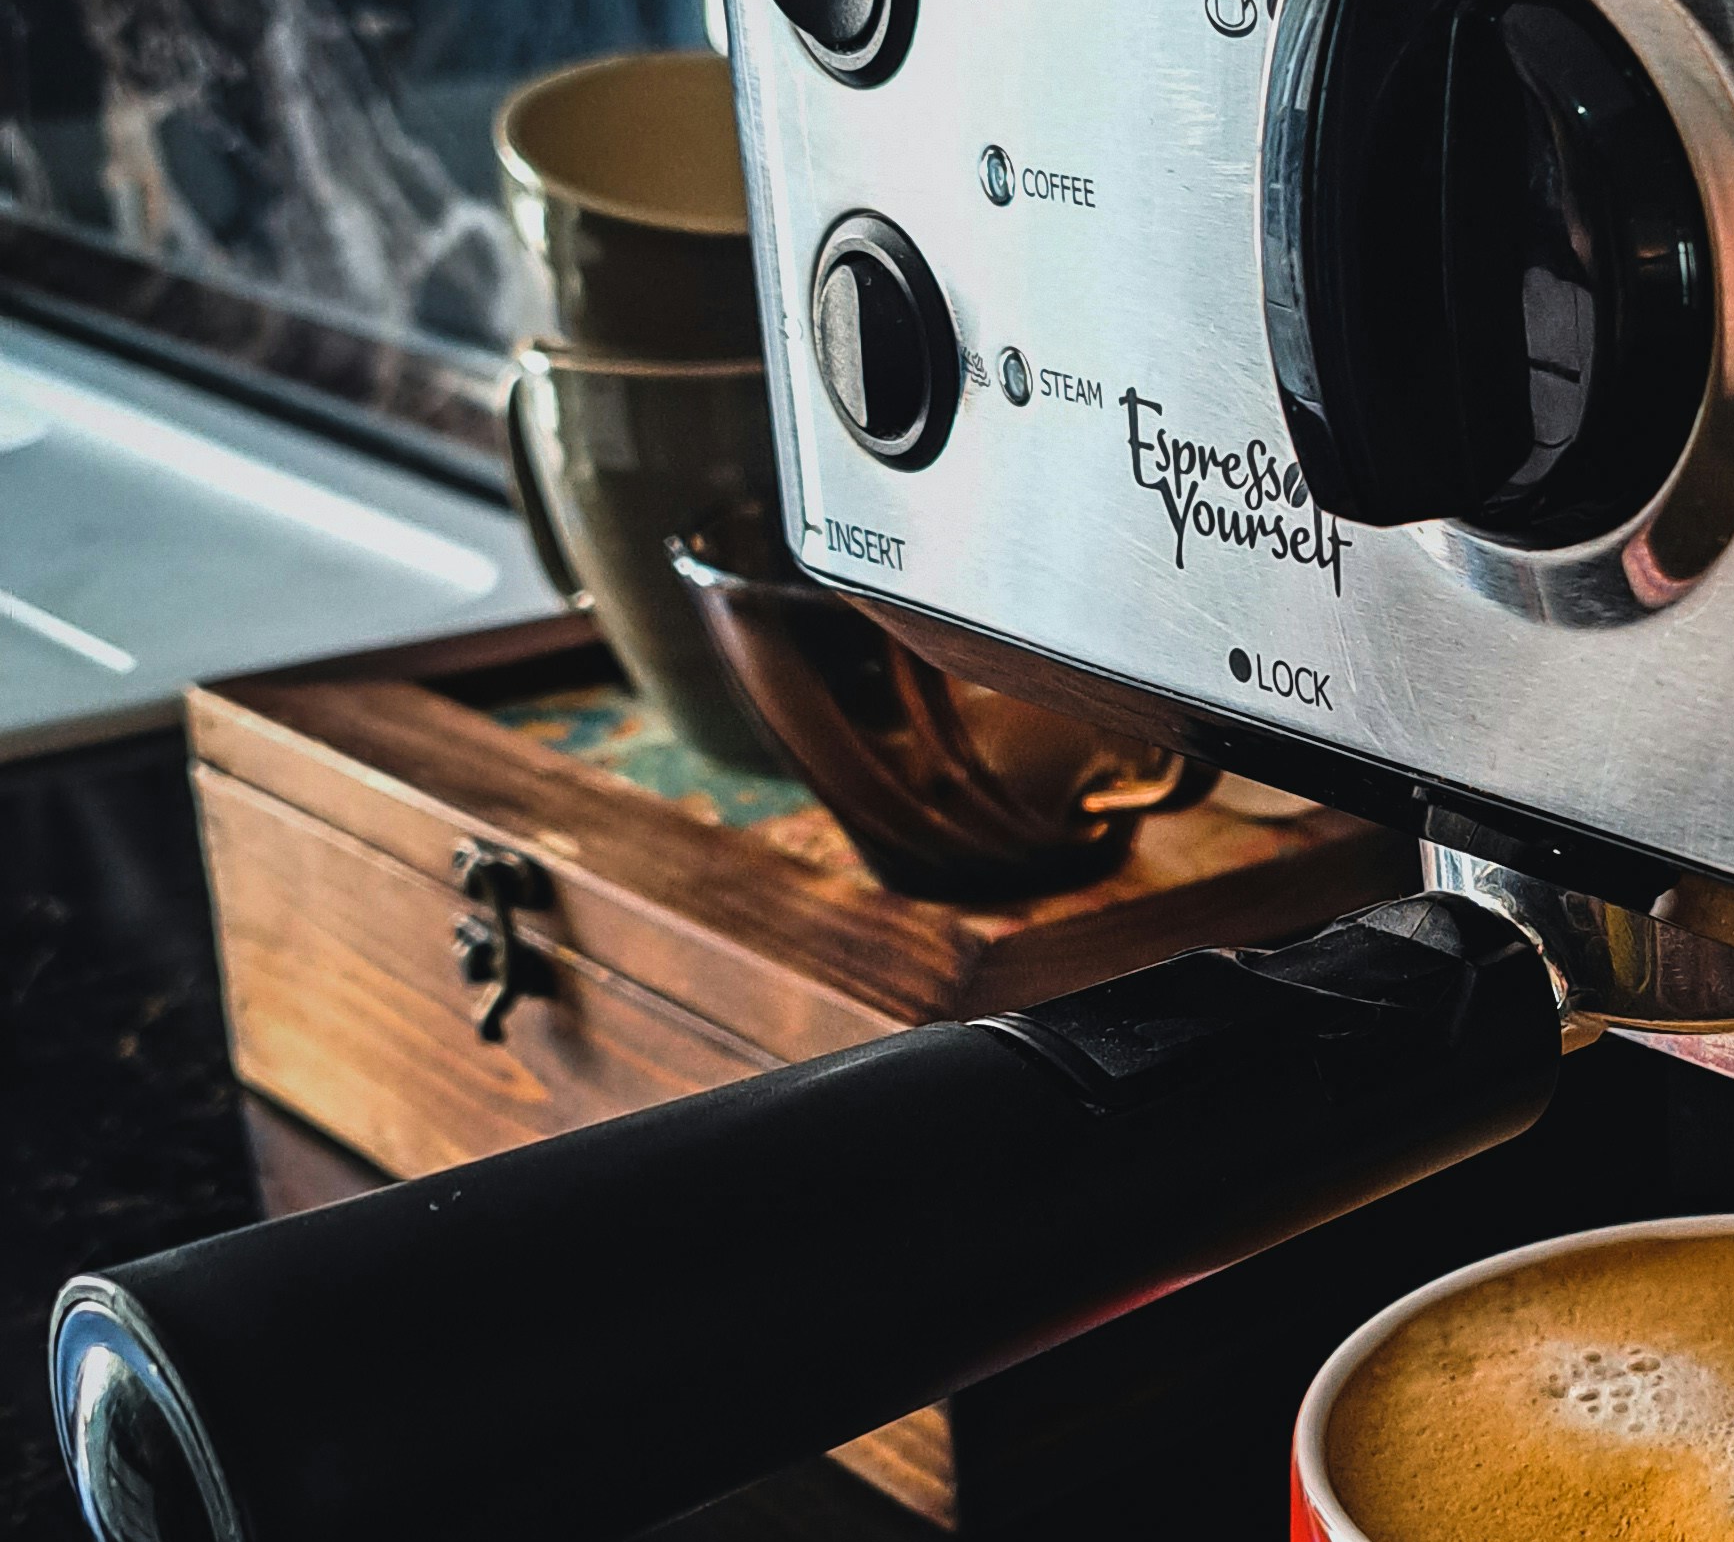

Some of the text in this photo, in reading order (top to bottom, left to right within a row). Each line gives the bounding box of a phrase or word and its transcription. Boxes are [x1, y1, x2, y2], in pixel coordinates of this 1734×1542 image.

[1022, 167, 1096, 208] COFFEE
[1040, 368, 1103, 409] STEAM
[825, 517, 906, 571] INSERT
[1159, 476, 1353, 598] Yourself
[1256, 653, 1333, 711] LOCK
